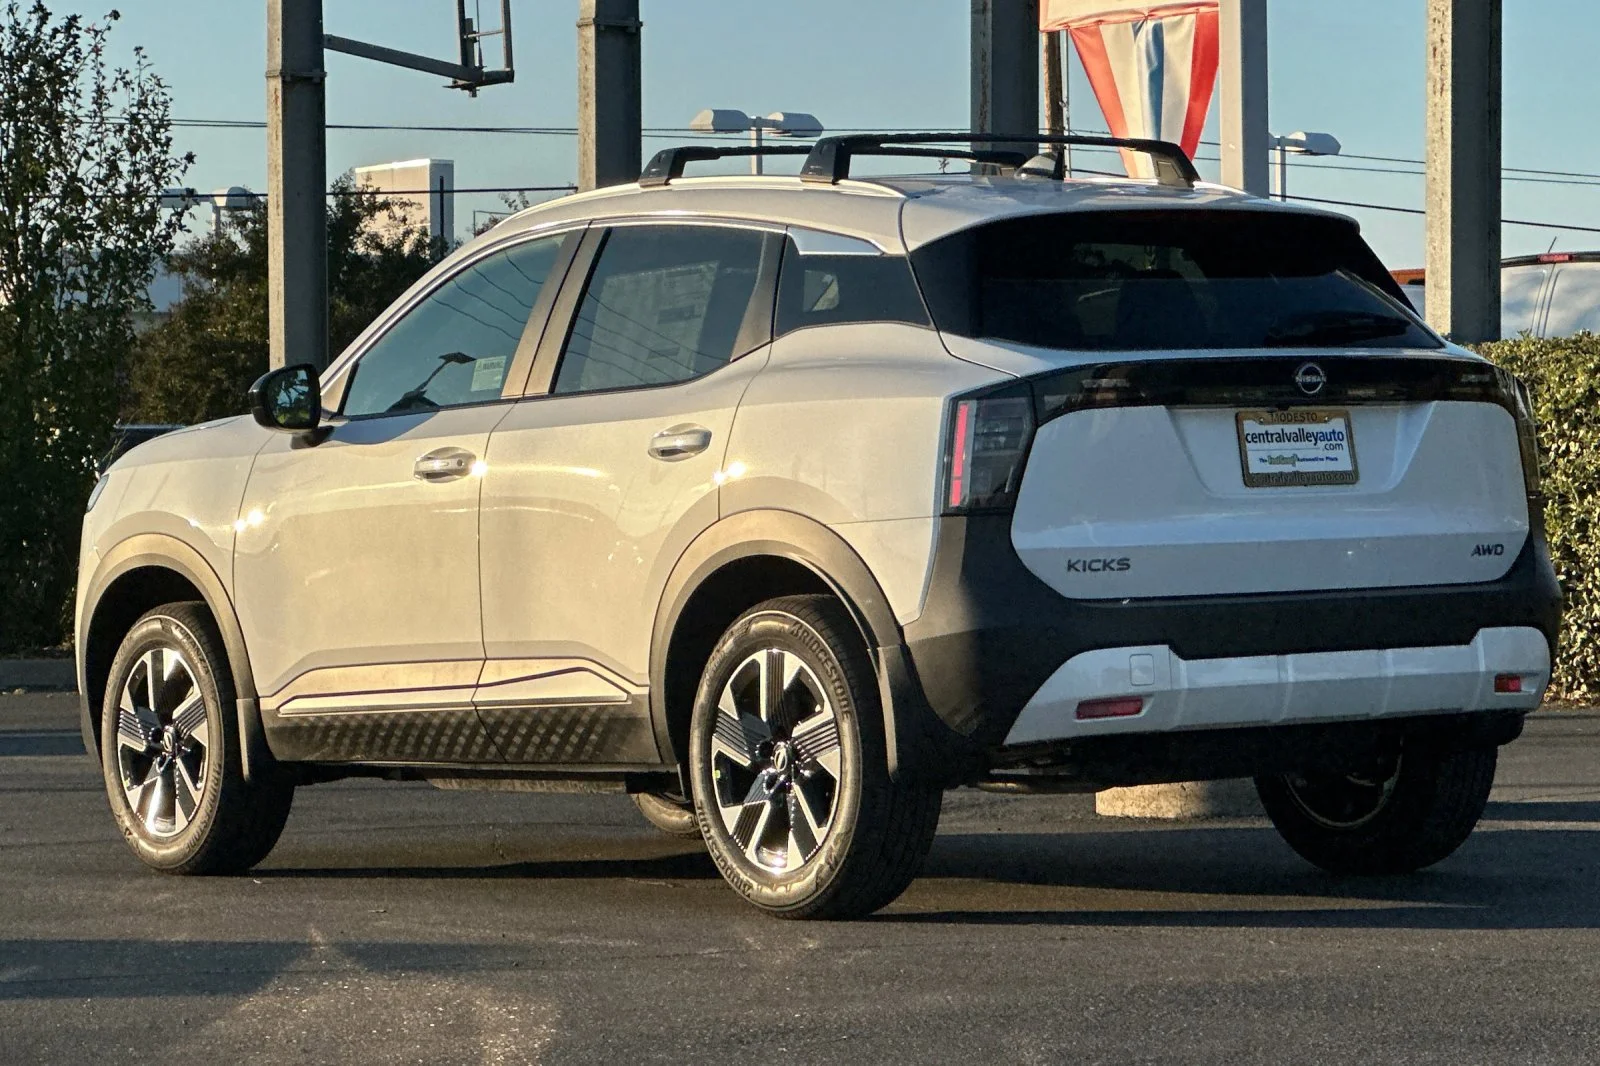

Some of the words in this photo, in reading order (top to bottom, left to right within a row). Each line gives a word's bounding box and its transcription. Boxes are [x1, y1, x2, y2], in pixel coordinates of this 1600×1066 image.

[1295, 375, 1327, 383] NISSAN
[1270, 412, 1319, 423] MODESTO
[1245, 428, 1345, 446] centralvalleyauto
[1322, 442, 1344, 452] .com
[1470, 543, 1505, 557] AWD
[1067, 557, 1131, 573] KICKS
[788, 621, 852, 721] BRIDGESTONE
